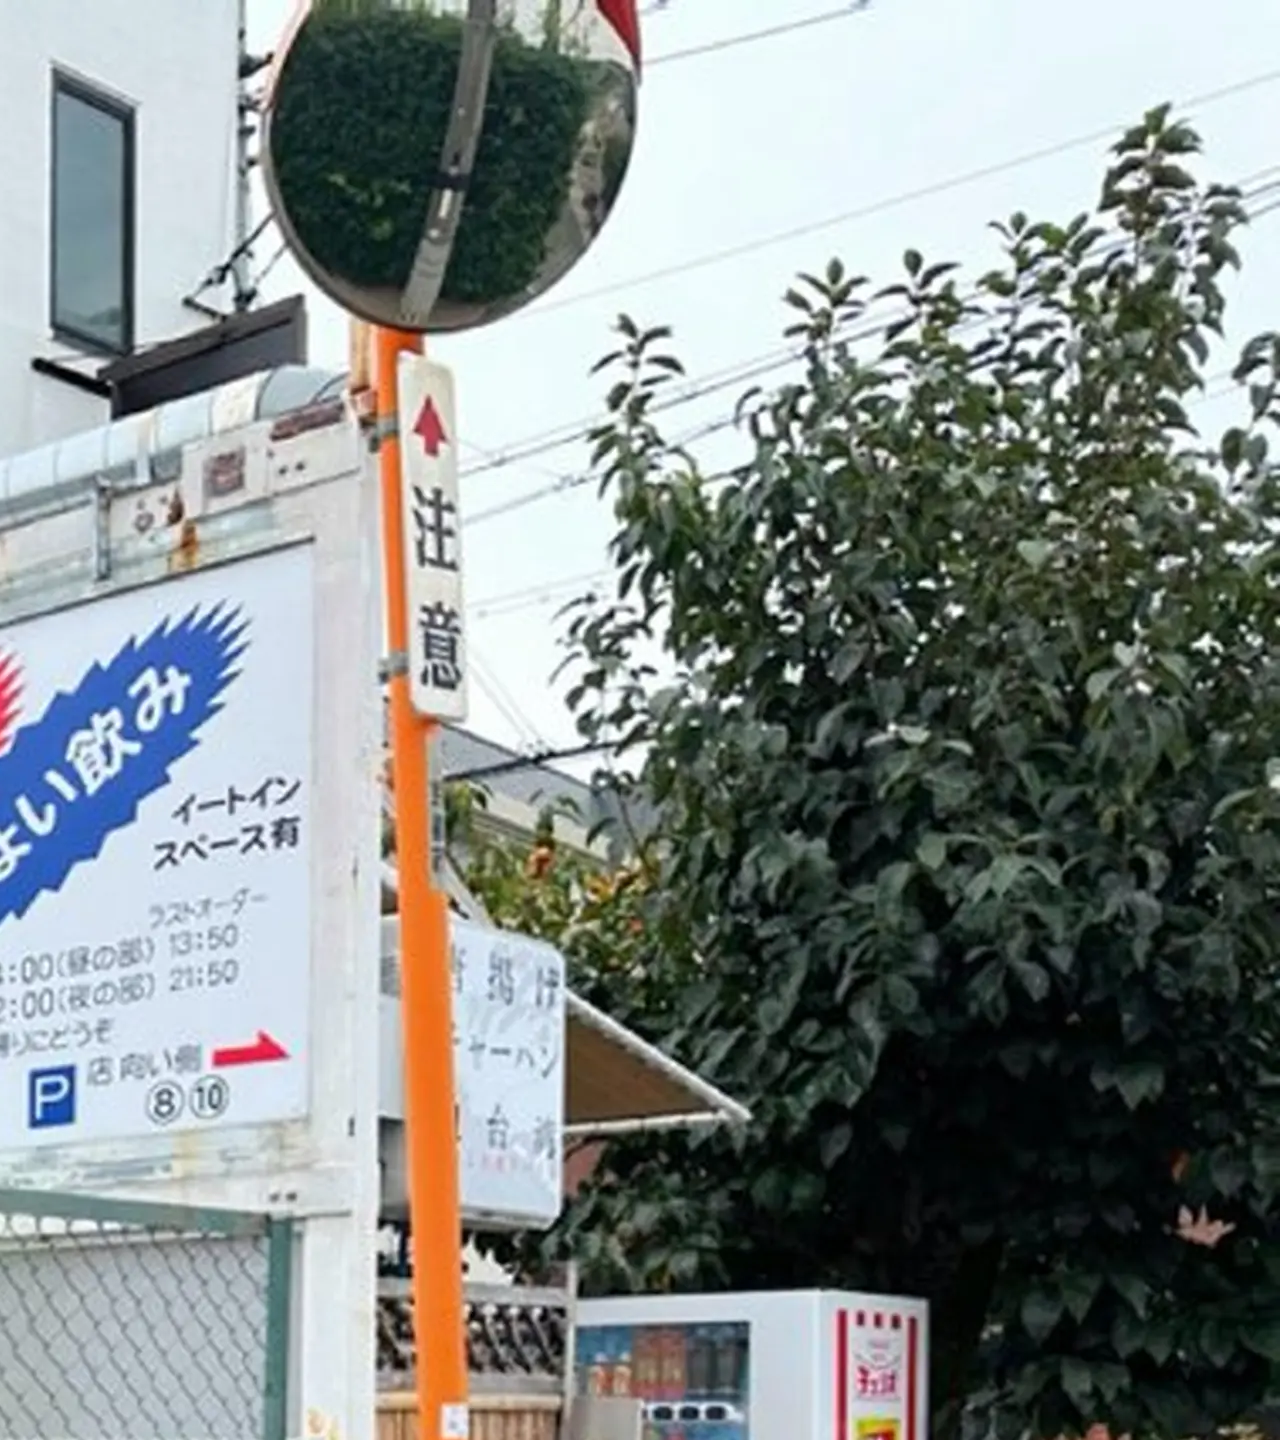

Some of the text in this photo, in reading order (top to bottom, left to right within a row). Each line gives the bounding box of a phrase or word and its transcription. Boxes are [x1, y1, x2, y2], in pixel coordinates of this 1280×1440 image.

[412, 485, 463, 692] 注意
[170, 776, 302, 825] イートイン
[153, 815, 302, 871] スペース有
[148, 887, 269, 929] ラストオーダー
[168, 921, 239, 957] 13:50
[169, 958, 240, 992] 21:50
[33, 1072, 71, 1122] P
